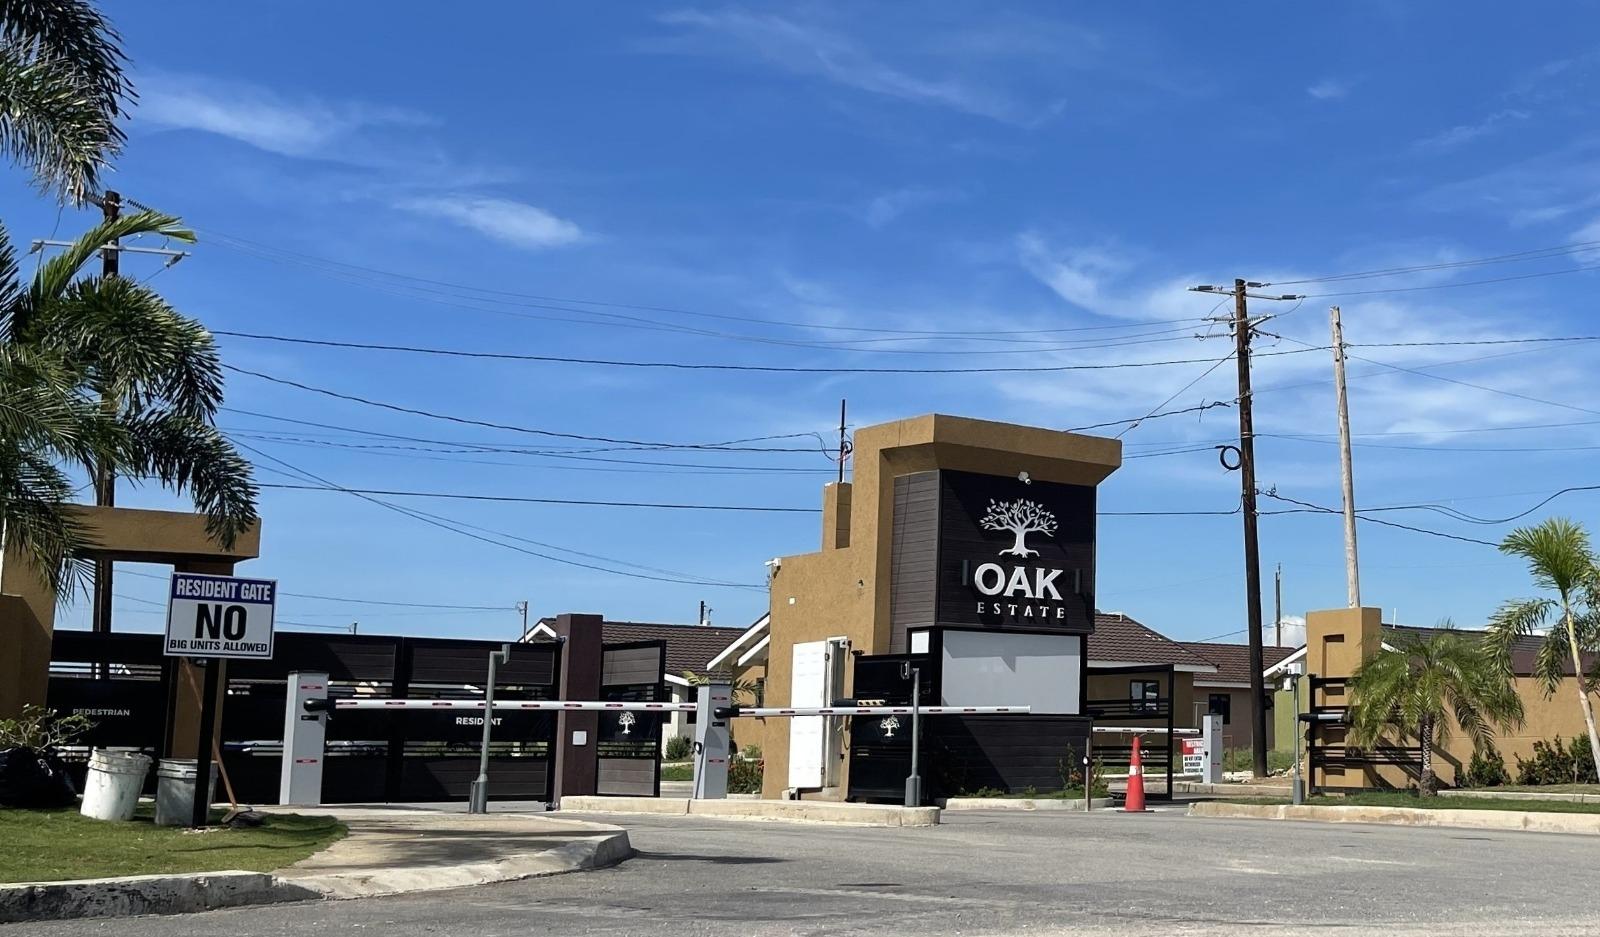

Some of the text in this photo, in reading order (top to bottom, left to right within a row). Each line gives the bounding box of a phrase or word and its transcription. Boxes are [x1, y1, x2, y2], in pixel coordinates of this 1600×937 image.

[176, 578, 271, 601] RESIDENT GATE
[974, 562, 1064, 601] OAK
[976, 601, 1065, 619] ESTATE
[195, 603, 247, 641] NO
[169, 639, 267, 653] BIG UNITS ALLOWED
[72, 708, 130, 716] PEDESTRIAN
[455, 716, 502, 726] RESIDNT
